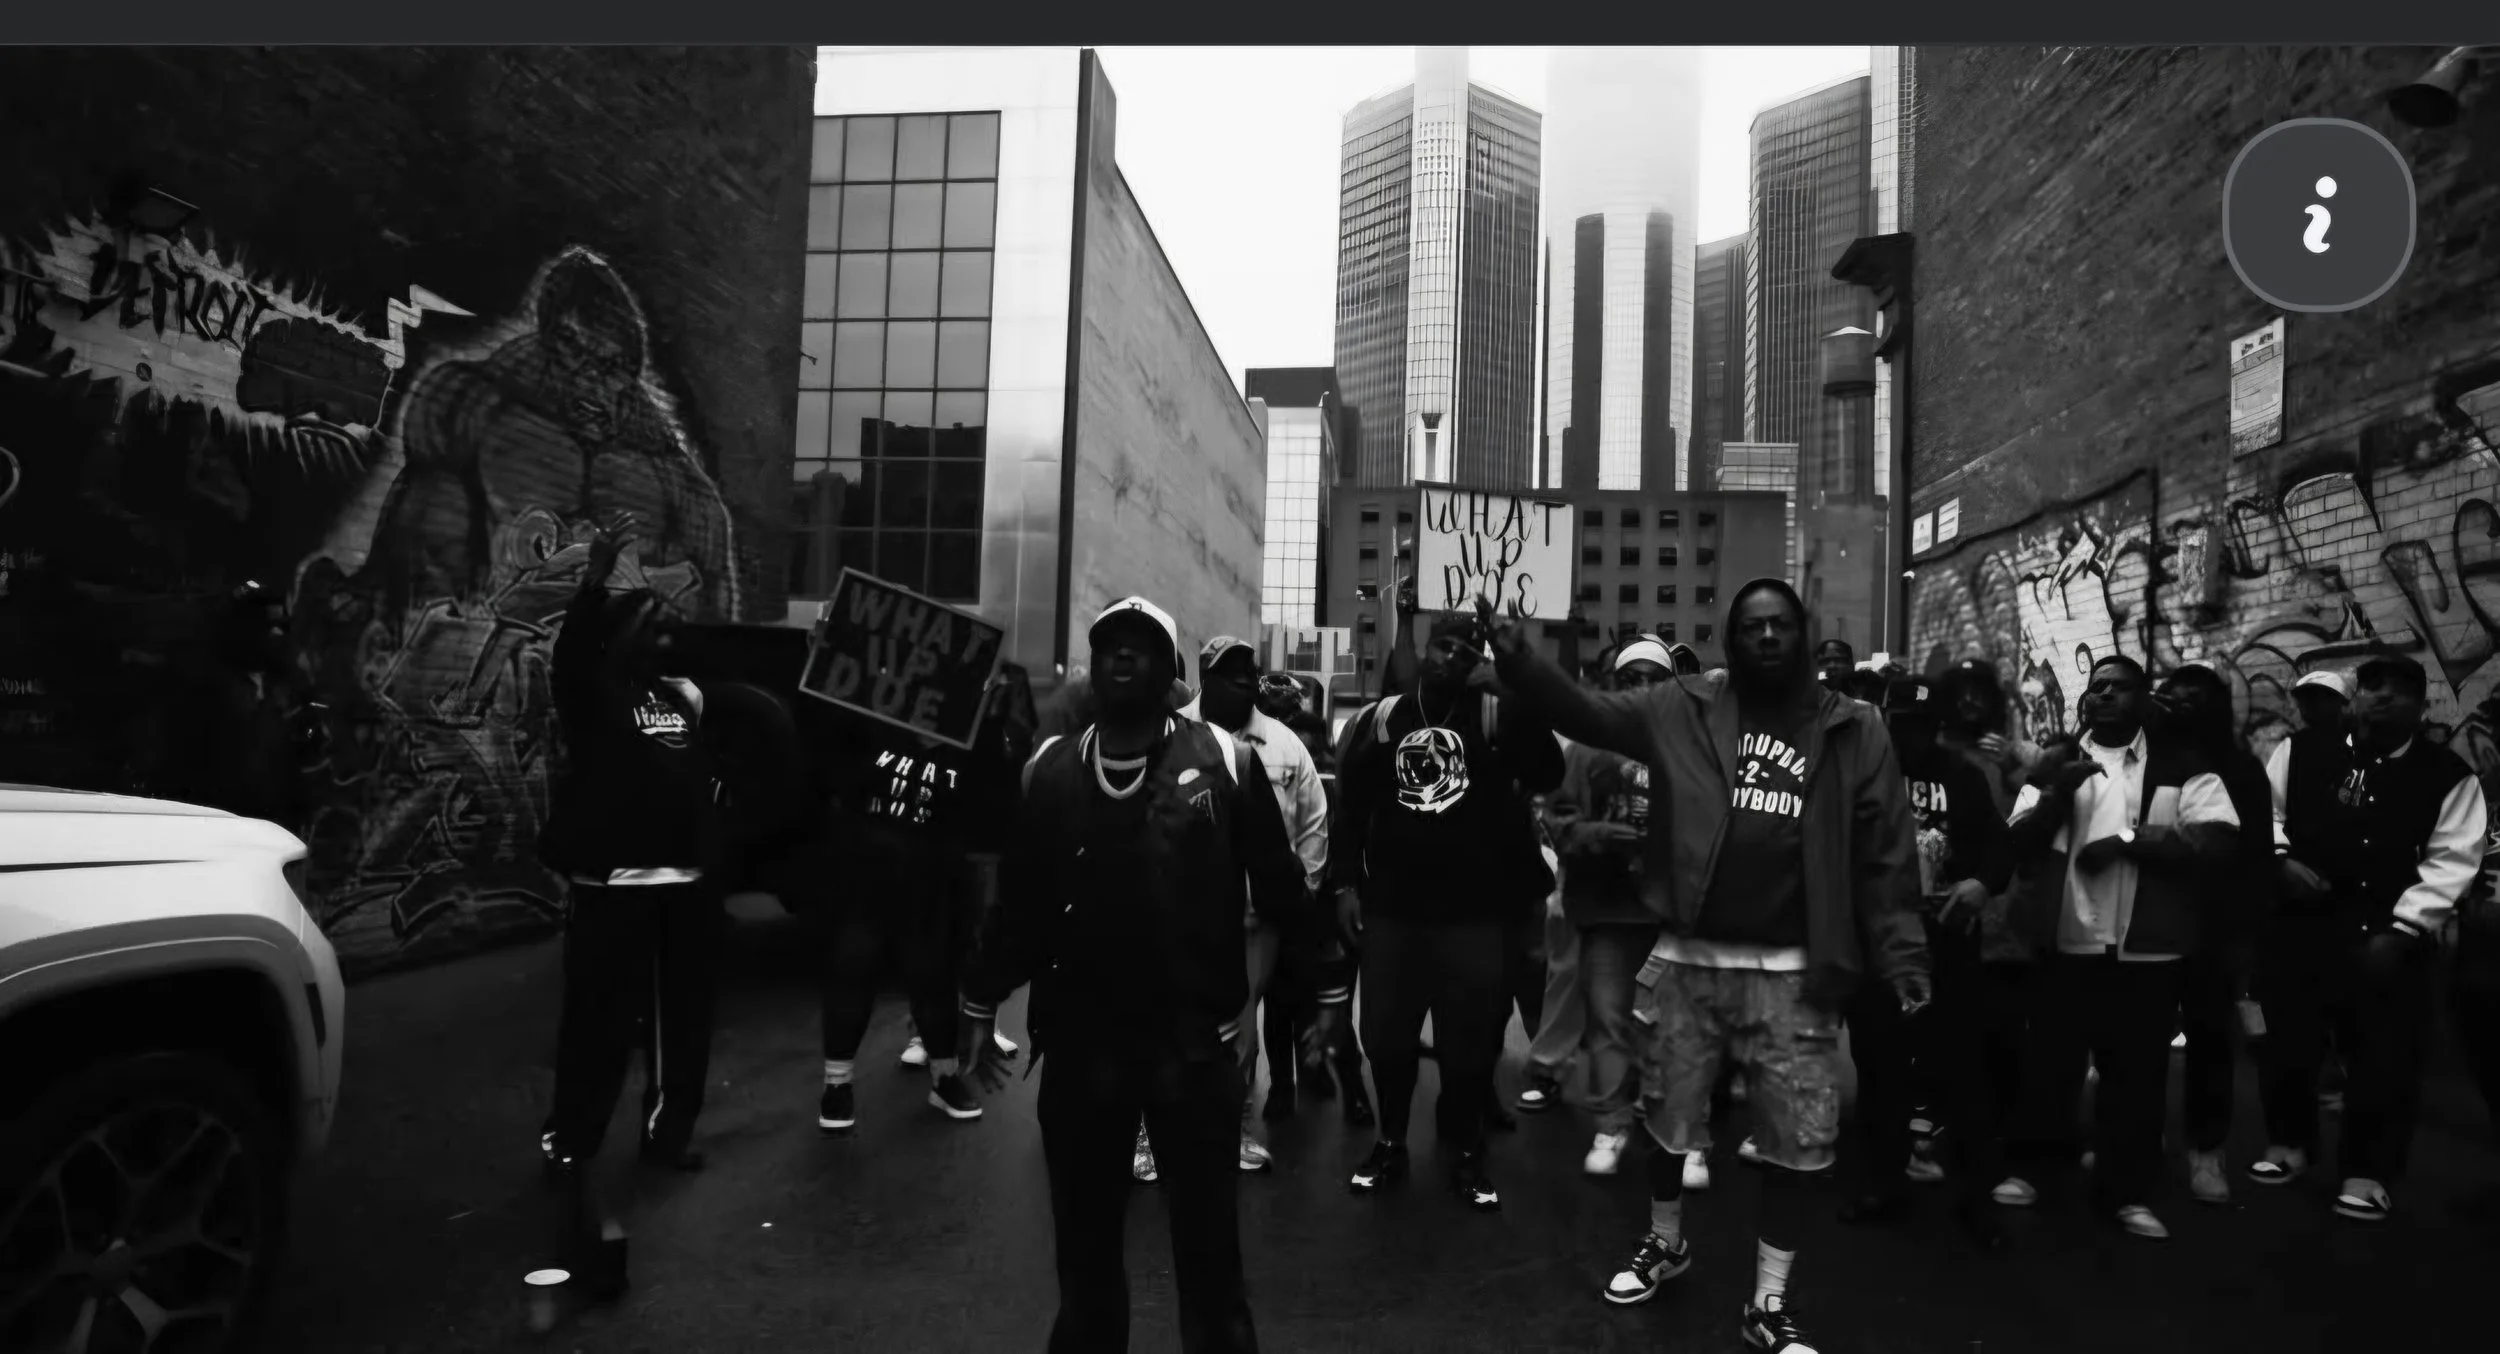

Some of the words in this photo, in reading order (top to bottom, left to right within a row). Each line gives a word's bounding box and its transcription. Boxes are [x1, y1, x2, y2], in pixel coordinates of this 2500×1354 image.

[1426, 490, 1567, 546] WHAT
[1459, 531, 1523, 583] UP
[1443, 564, 1538, 619] DOE
[850, 580, 997, 666] WHAT
[866, 634, 939, 686] UP
[824, 651, 946, 738] DOE
[875, 750, 957, 789] WHAT
[1904, 775, 1948, 812] CH
